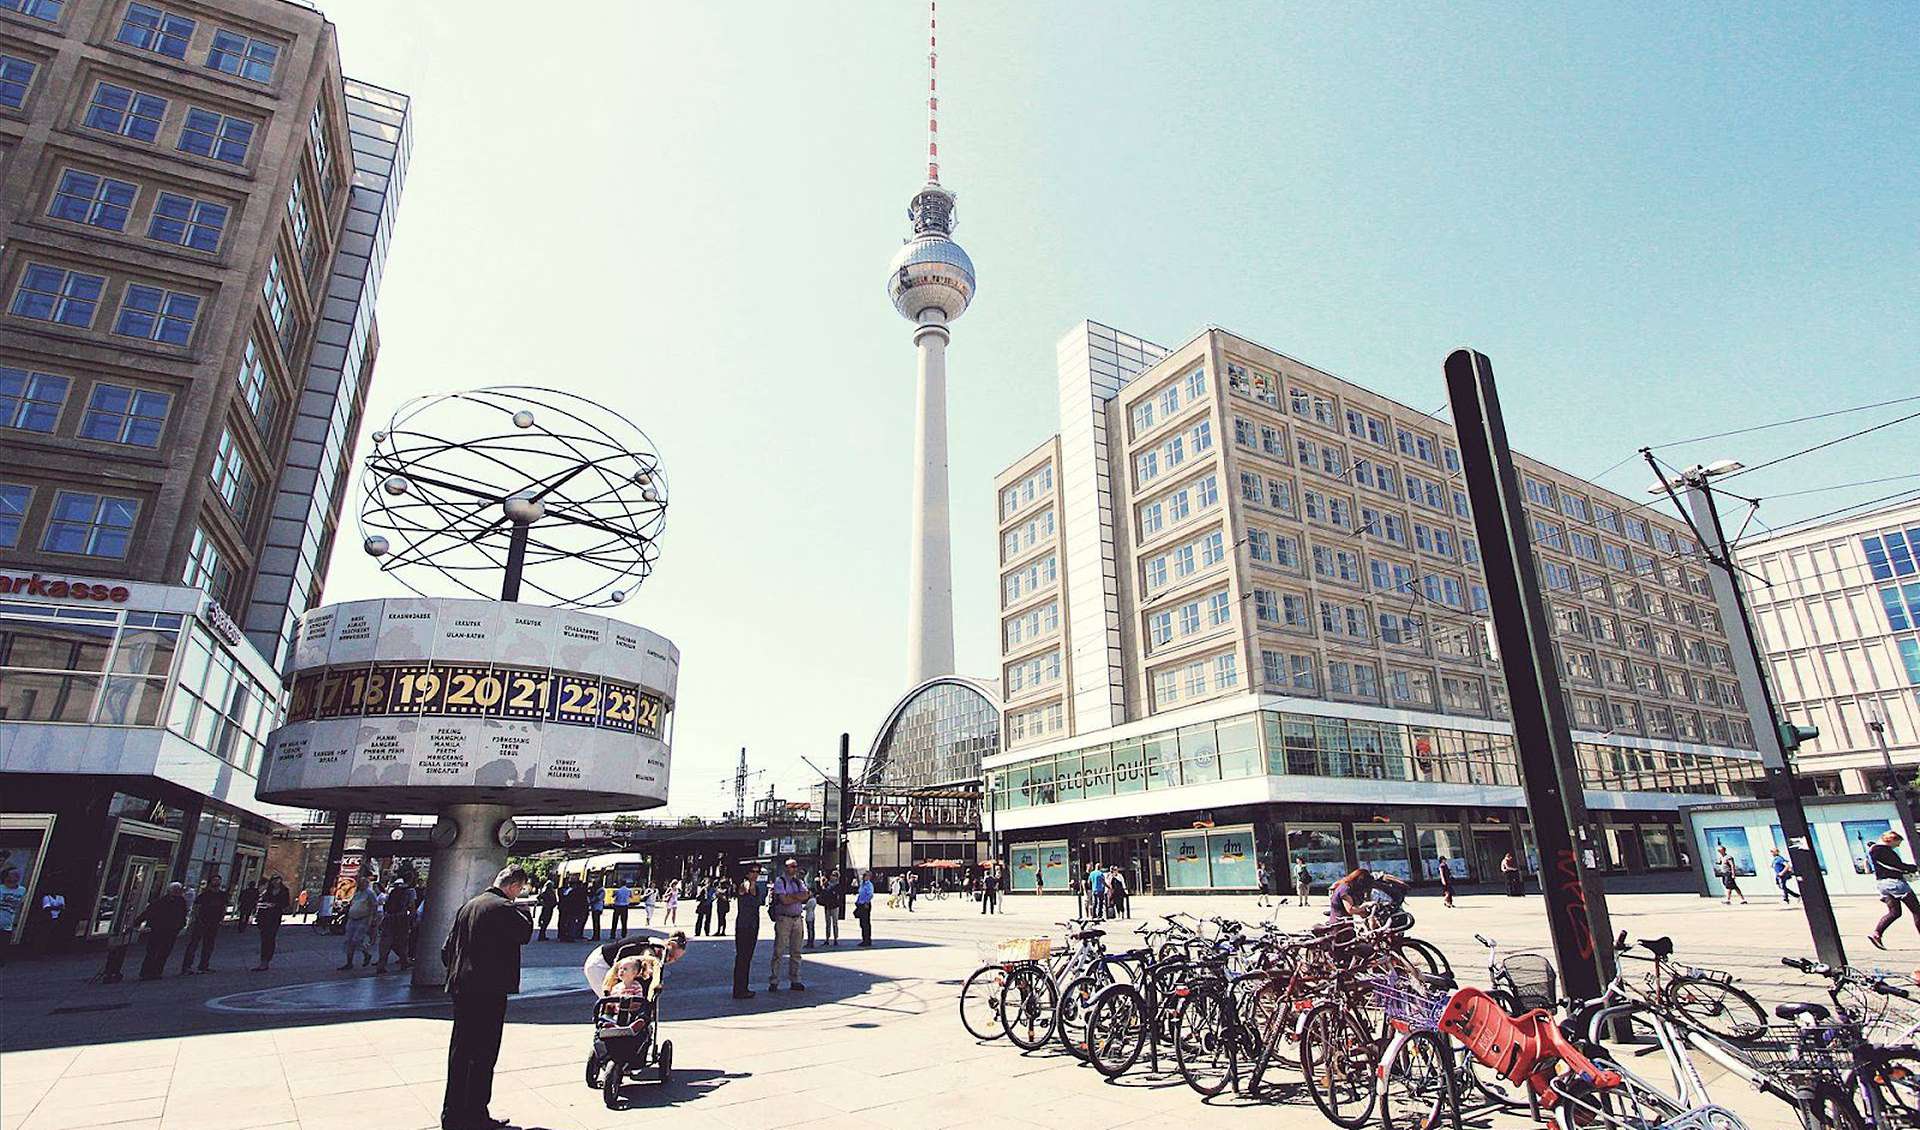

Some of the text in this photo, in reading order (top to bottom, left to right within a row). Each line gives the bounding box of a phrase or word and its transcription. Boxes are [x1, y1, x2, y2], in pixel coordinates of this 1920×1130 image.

[350, 674, 385, 706] 18
[399, 673, 441, 704] 19
[447, 674, 502, 707] 20
[509, 678, 548, 709] 21
[560, 684, 602, 715] 22
[605, 691, 636, 722] 23
[638, 699, 658, 729] 24
[1057, 757, 1159, 792] CLOCKHOUSE
[341, 857, 362, 865] KFC
[1179, 842, 1195, 855] dm
[1223, 840, 1242, 853] dm
